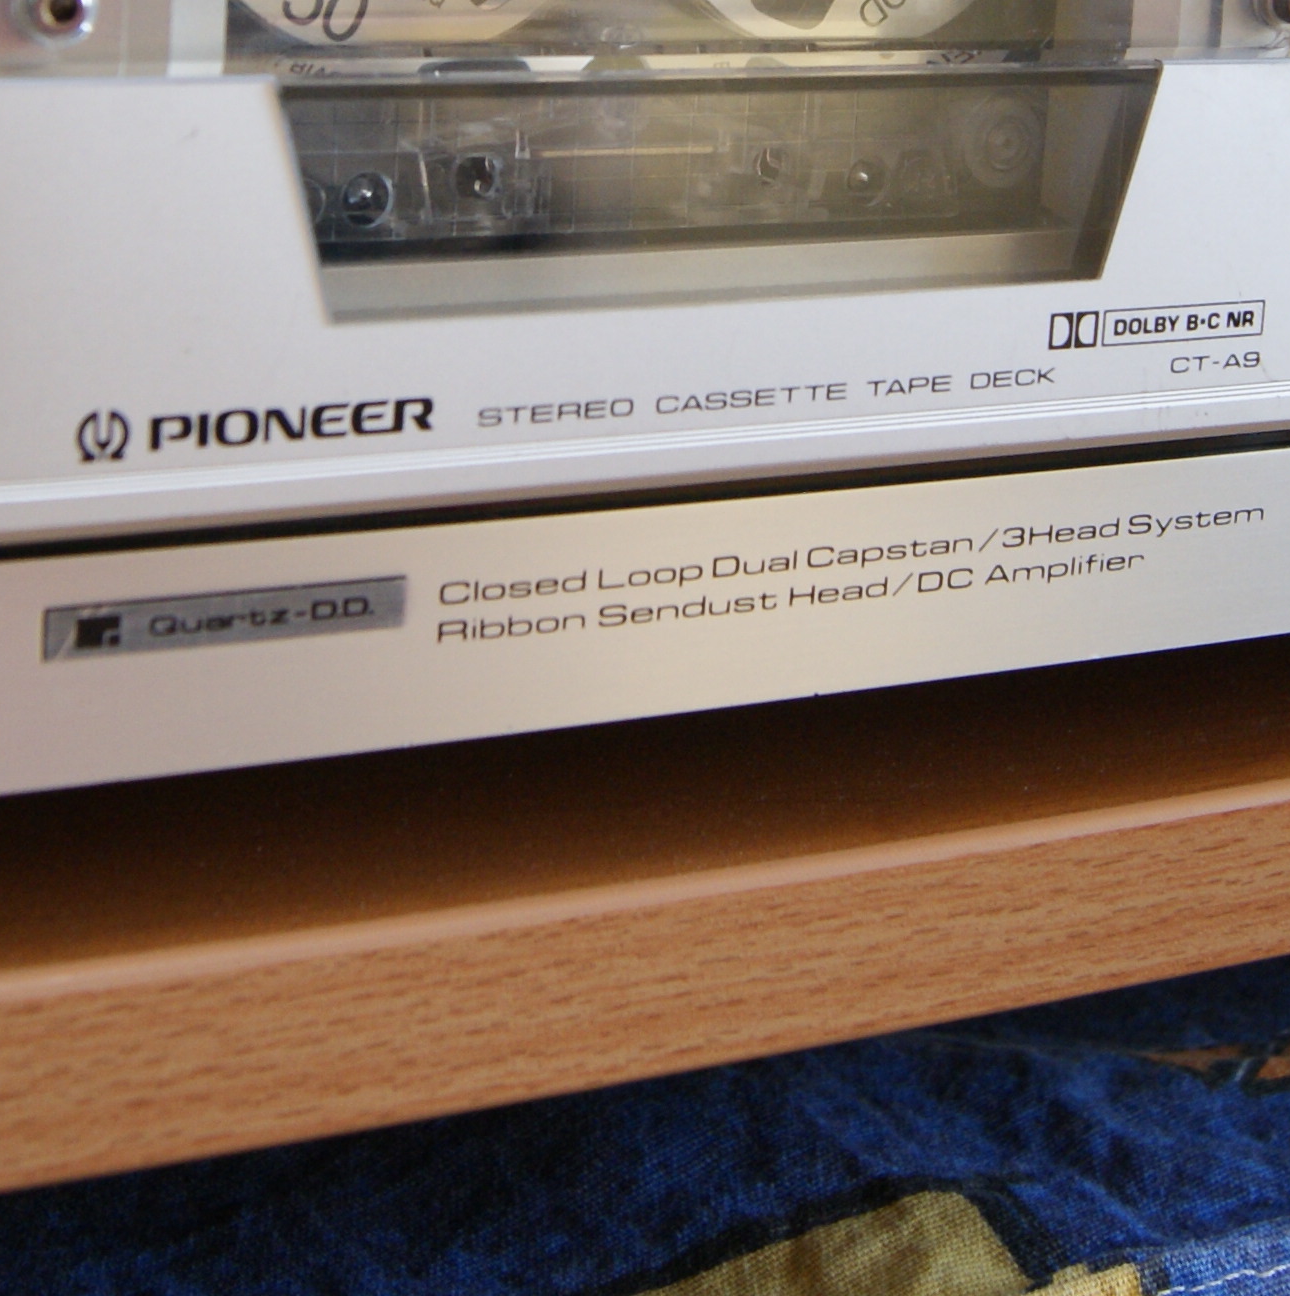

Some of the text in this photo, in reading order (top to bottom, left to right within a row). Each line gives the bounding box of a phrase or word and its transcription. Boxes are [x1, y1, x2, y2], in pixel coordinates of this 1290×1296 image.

[1112, 313, 1181, 338] DOLBY
[1227, 309, 1255, 329] NR
[1169, 350, 1262, 376] CT-A9
[148, 396, 435, 452] PIONEER
[478, 366, 1056, 427] STEREO CASSETTE TAPE DECK
[439, 569, 587, 606] Closed
[598, 564, 703, 590] Loop
[711, 547, 799, 579] Dual
[1127, 505, 1265, 538] System
[436, 613, 586, 643] Ribbon
[598, 589, 779, 628] Sendust
[984, 551, 1146, 586] Amplifier
